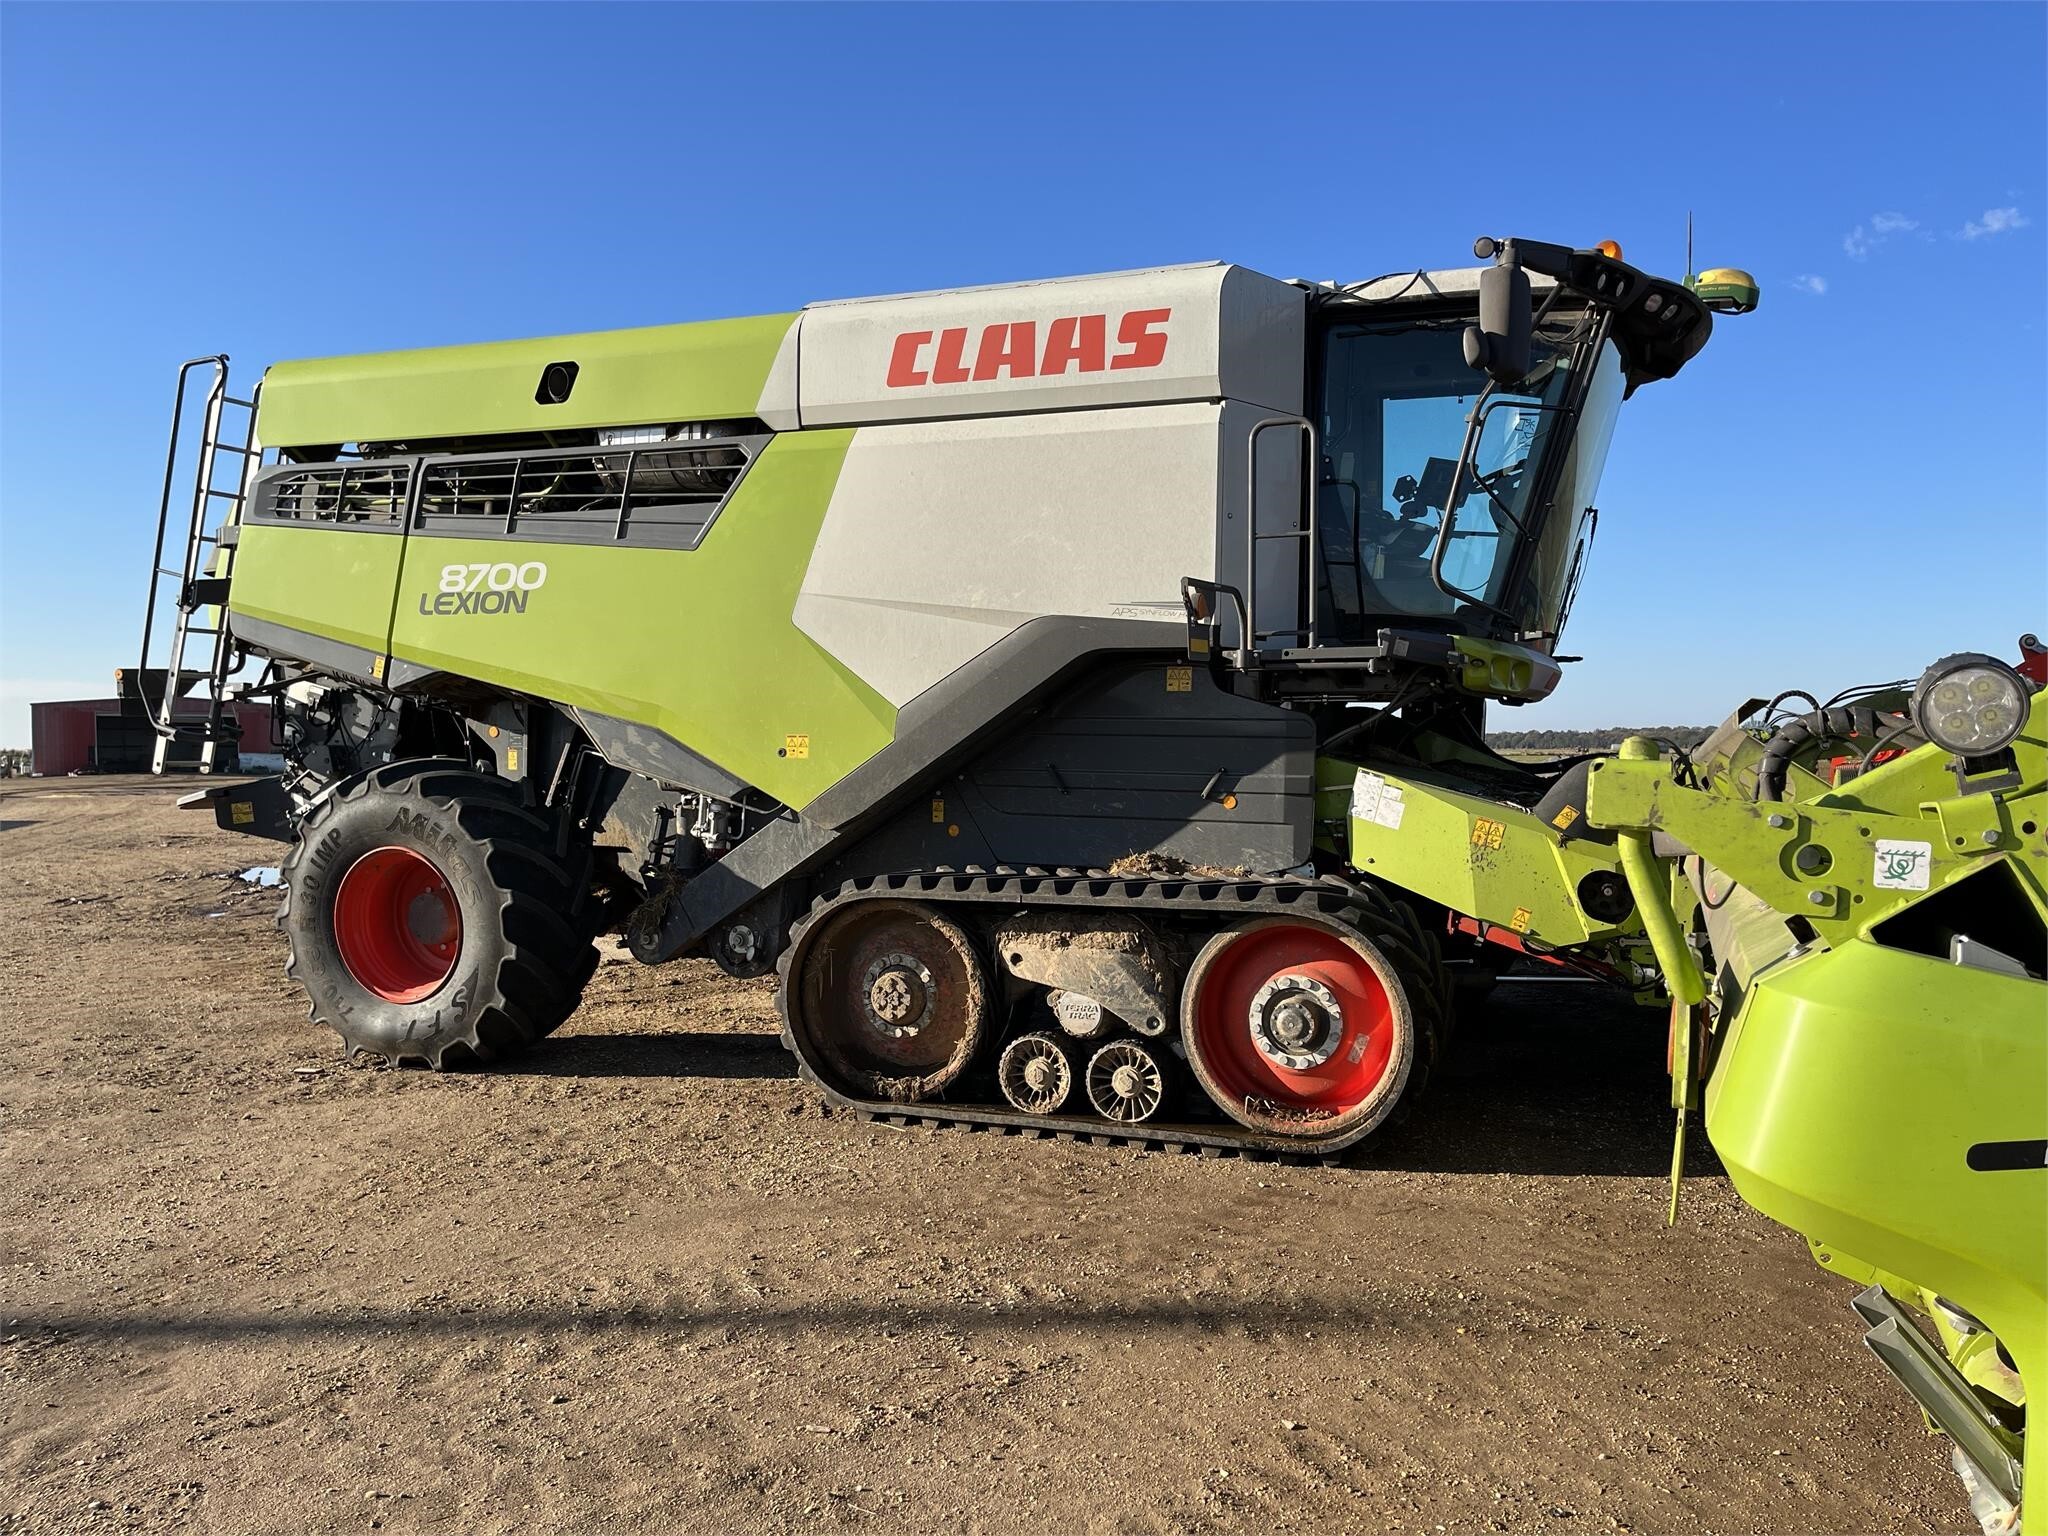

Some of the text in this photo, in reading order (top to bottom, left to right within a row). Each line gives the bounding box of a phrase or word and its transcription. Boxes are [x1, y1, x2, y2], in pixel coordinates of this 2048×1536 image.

[886, 308, 1171, 388] CLAAS
[439, 562, 547, 593] 8700
[419, 590, 529, 616] LEXION
[1112, 607, 1138, 617] APS
[311, 827, 342, 873] IMP
[385, 806, 482, 906] Mitas
[1065, 1003, 1099, 1013] TERRA
[1069, 1012, 1096, 1020] TRAC
